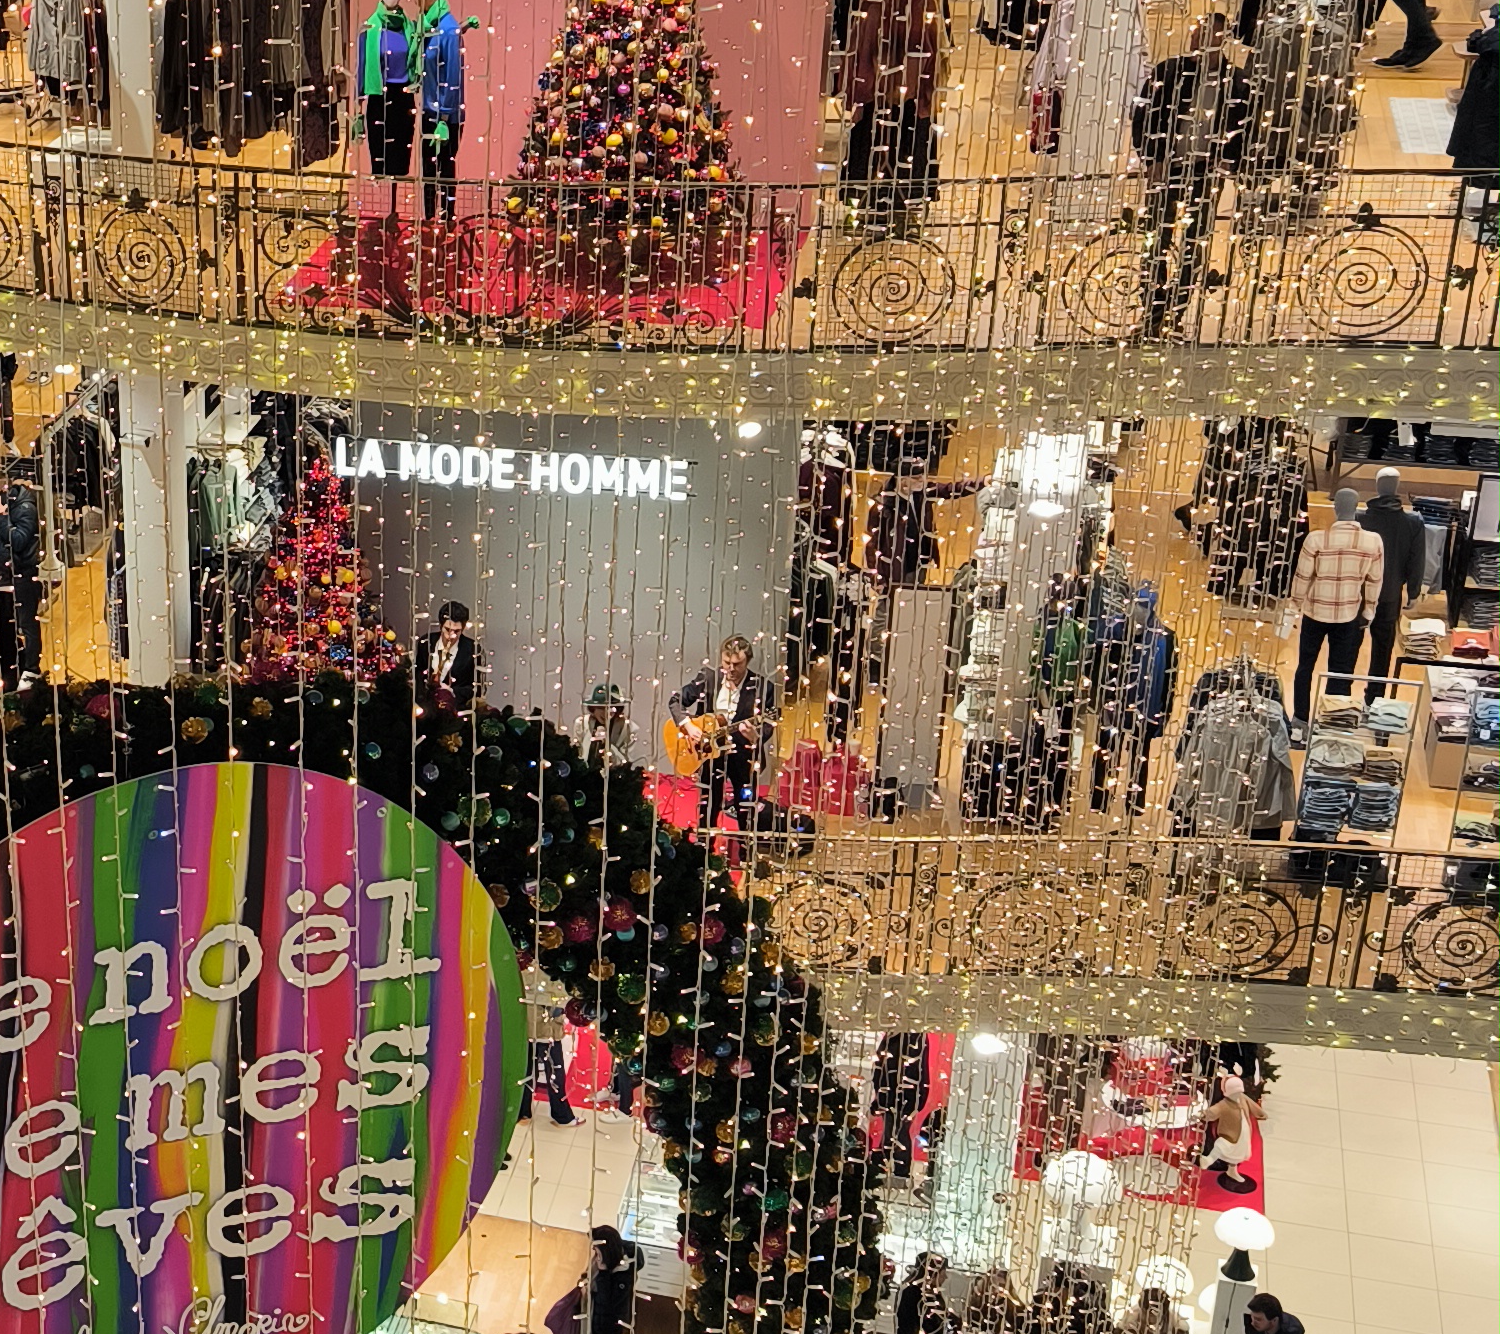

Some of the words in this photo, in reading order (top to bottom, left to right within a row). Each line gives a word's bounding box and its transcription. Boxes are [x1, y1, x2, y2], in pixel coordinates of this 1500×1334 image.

[334, 436, 387, 479] LA
[399, 442, 516, 490] MODE
[530, 451, 689, 502] HOMME
[88, 876, 442, 1027] noël
[125, 1024, 431, 1152] mes
